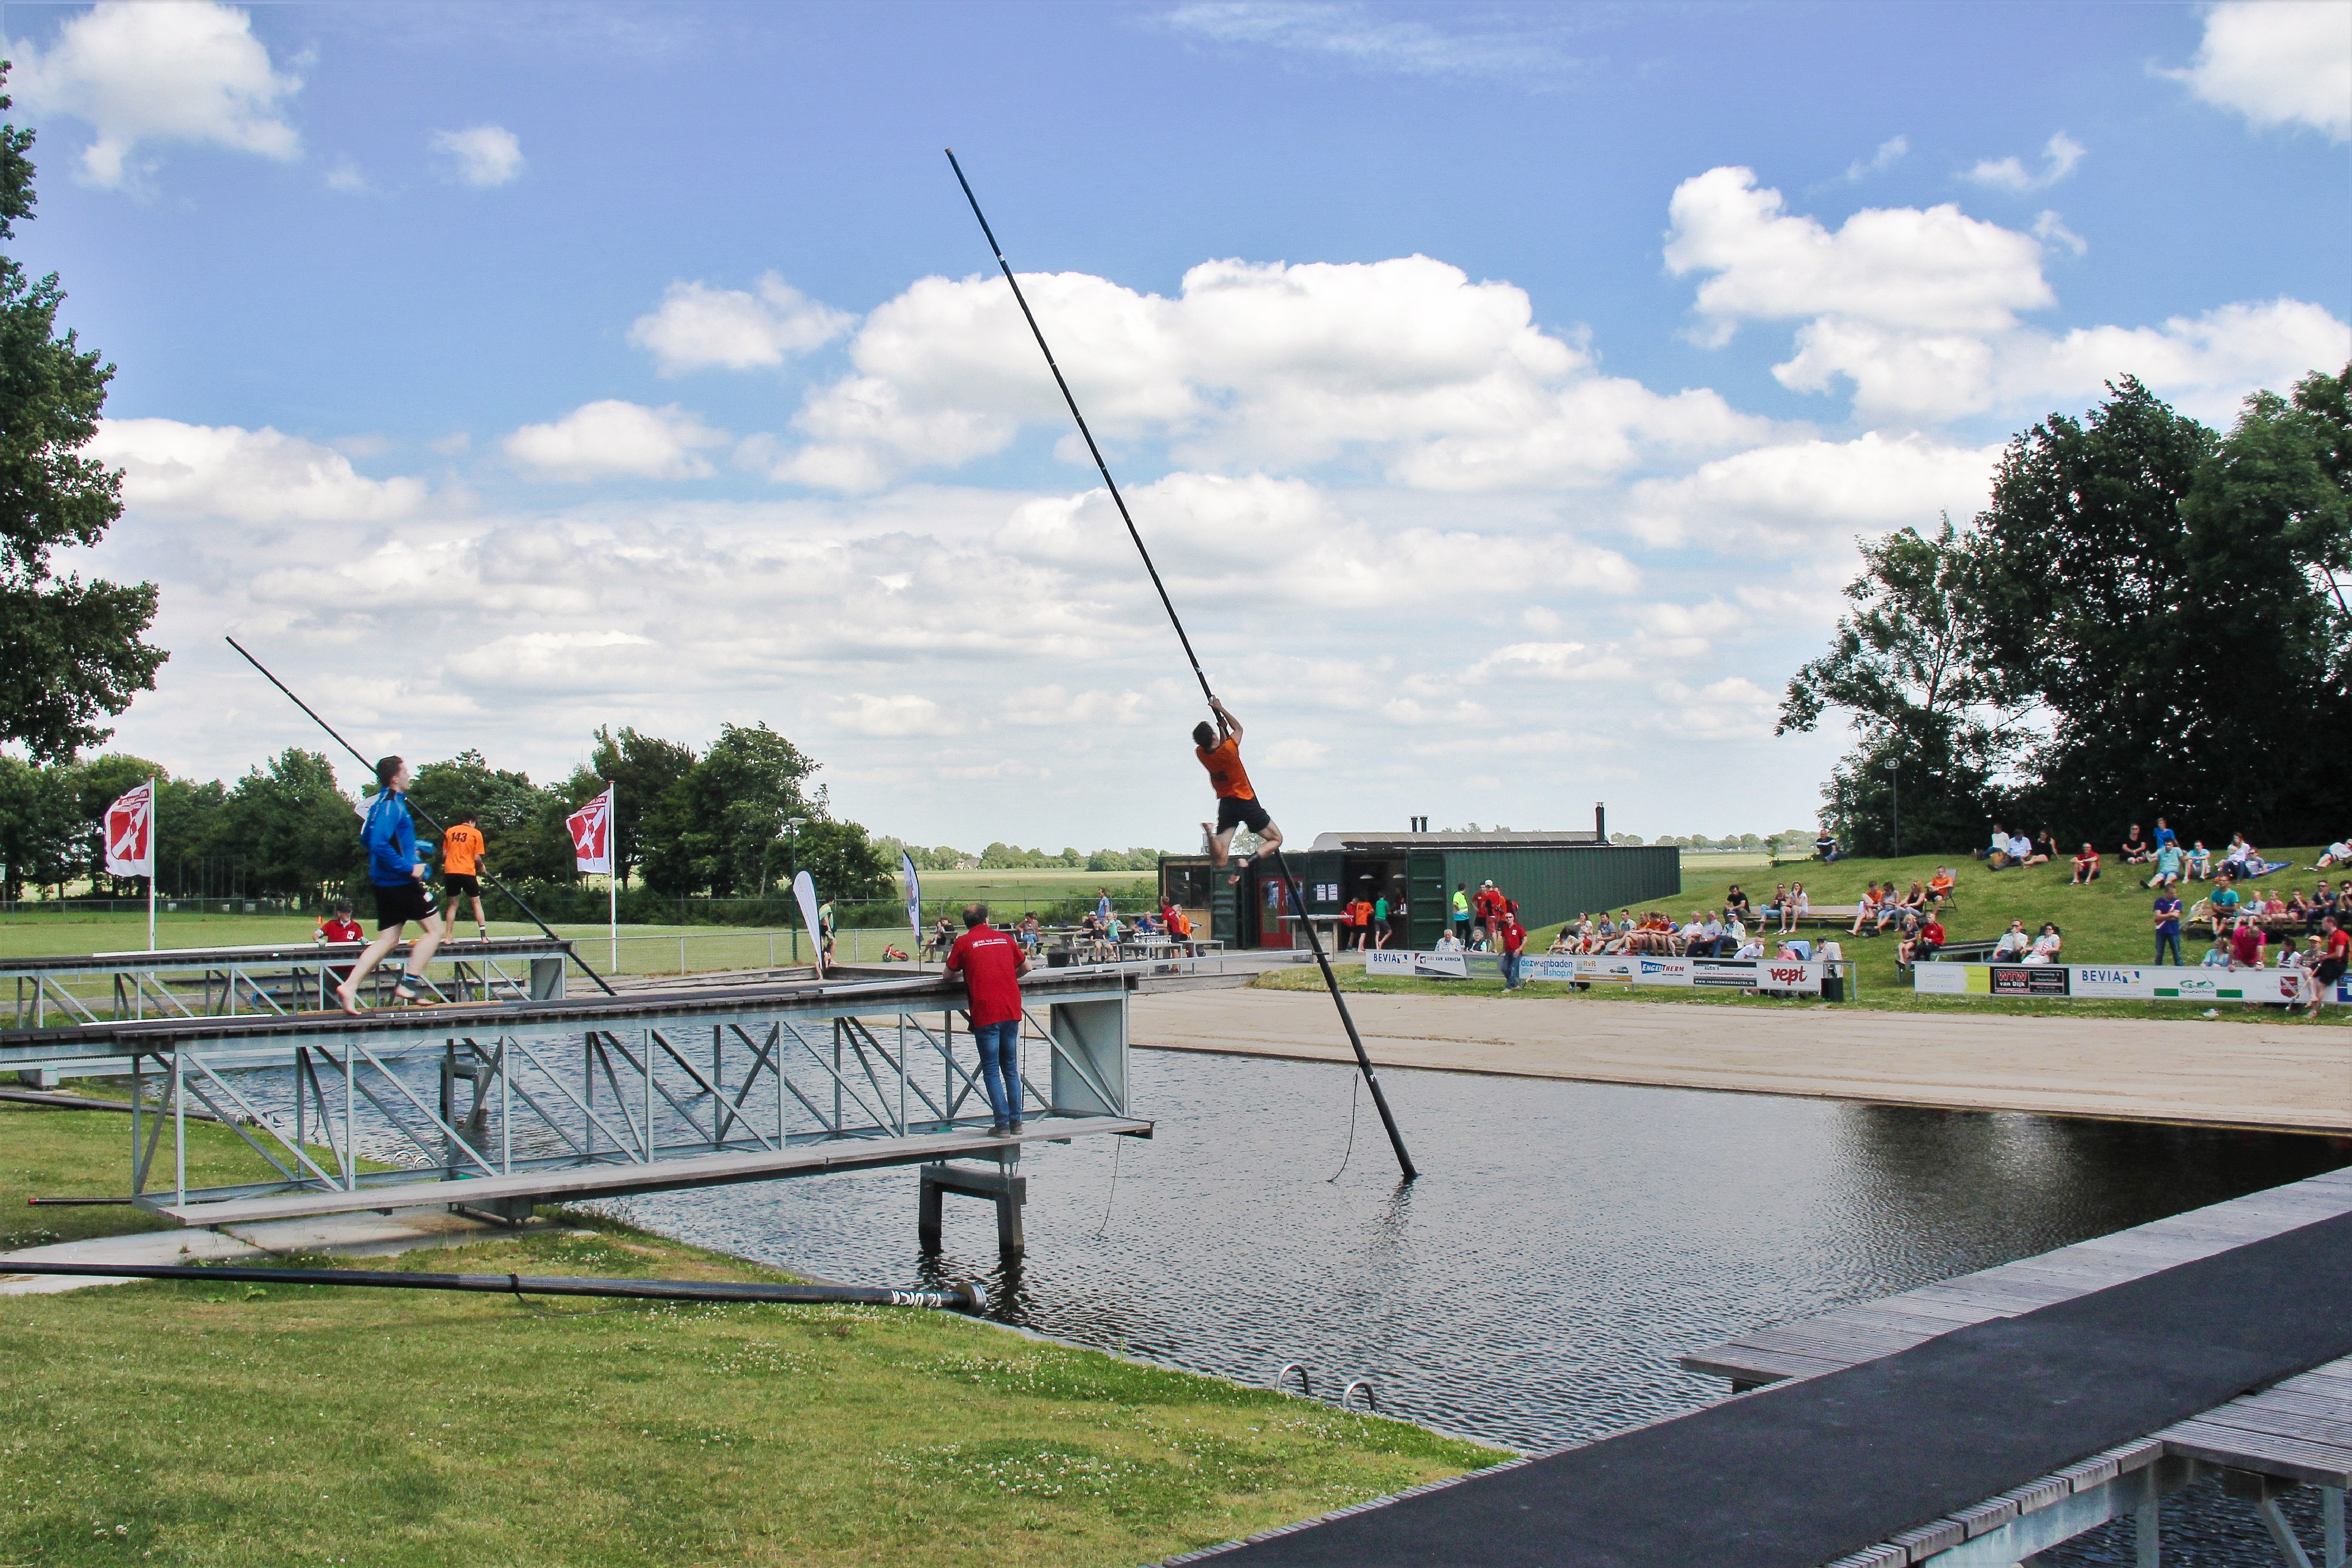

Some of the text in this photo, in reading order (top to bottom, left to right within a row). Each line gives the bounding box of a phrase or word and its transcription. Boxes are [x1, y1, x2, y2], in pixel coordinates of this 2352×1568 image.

[451, 832, 468, 842] 143
[1374, 953, 1397, 963] BEVIA
[1549, 968, 1573, 978] shop.nl
[1767, 966, 1808, 986] vept
[1996, 971, 2027, 982] WTW
[2082, 970, 2122, 982] BEVIA
